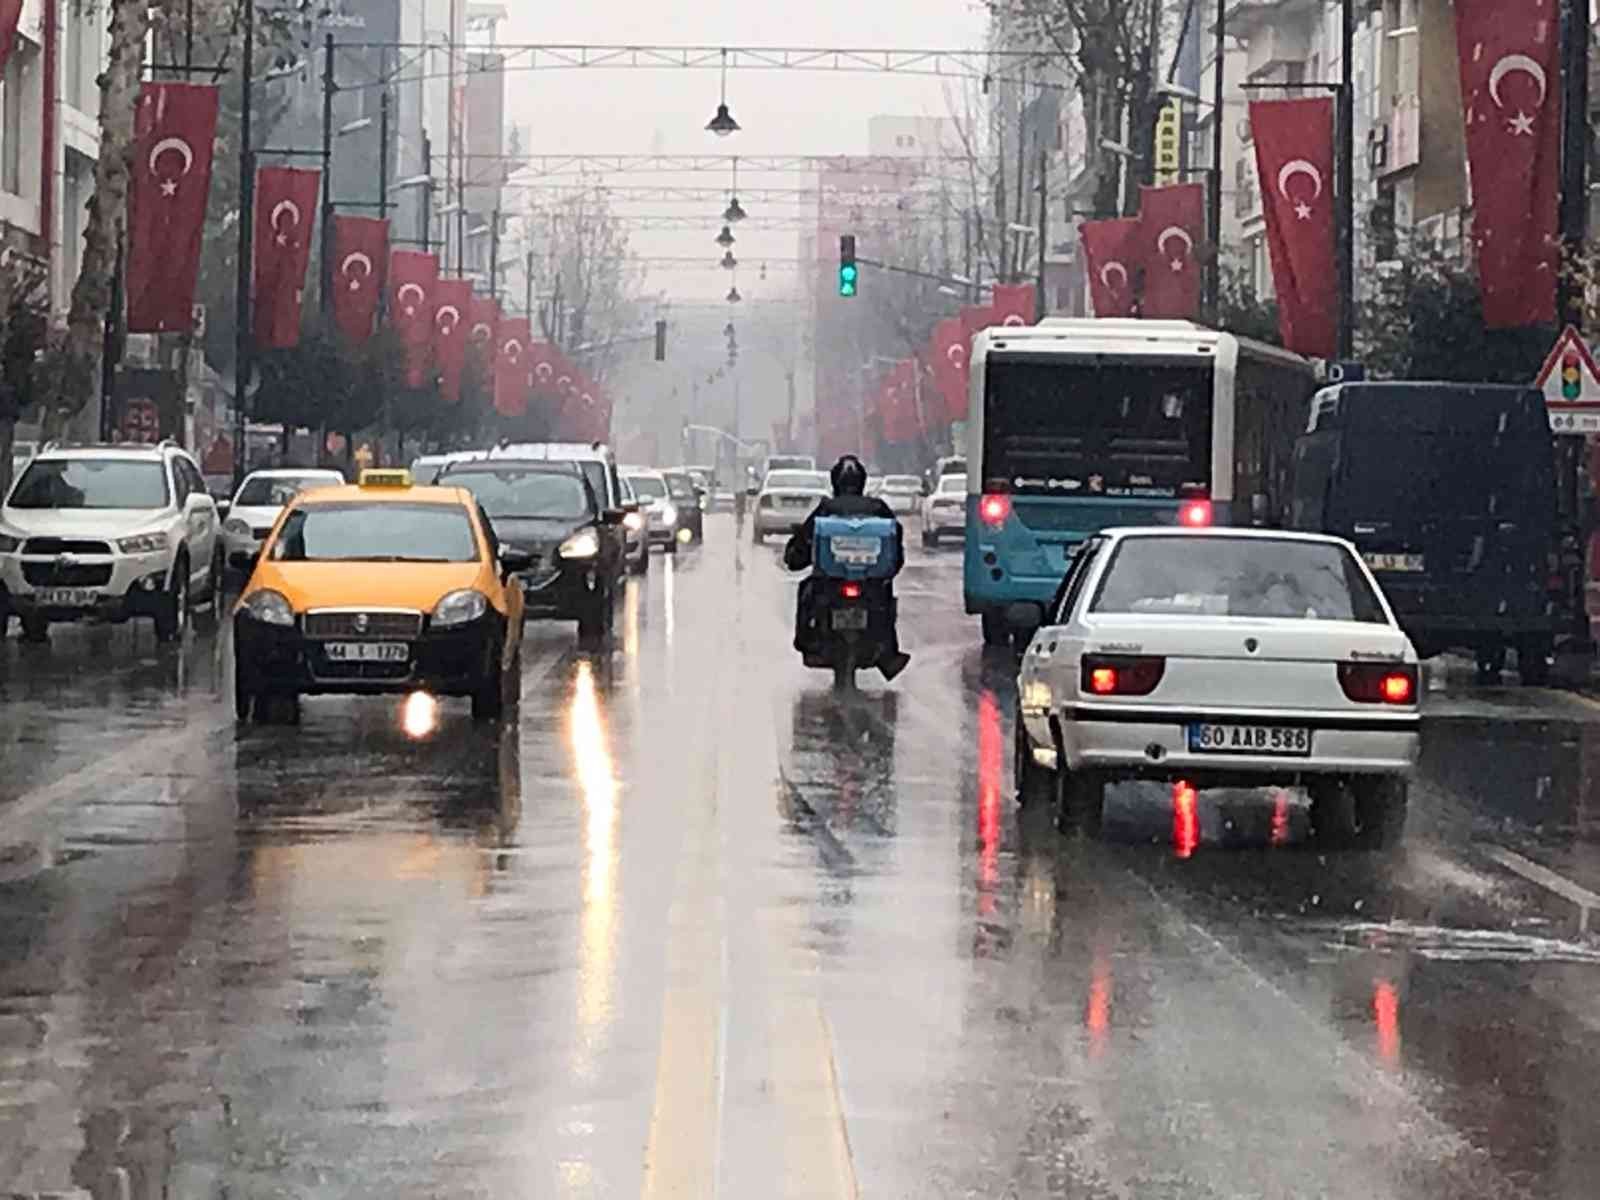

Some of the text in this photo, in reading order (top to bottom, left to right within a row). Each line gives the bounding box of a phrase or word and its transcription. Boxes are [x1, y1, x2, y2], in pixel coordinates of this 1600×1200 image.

[1201, 727, 1306, 749] 60 AAB 586
